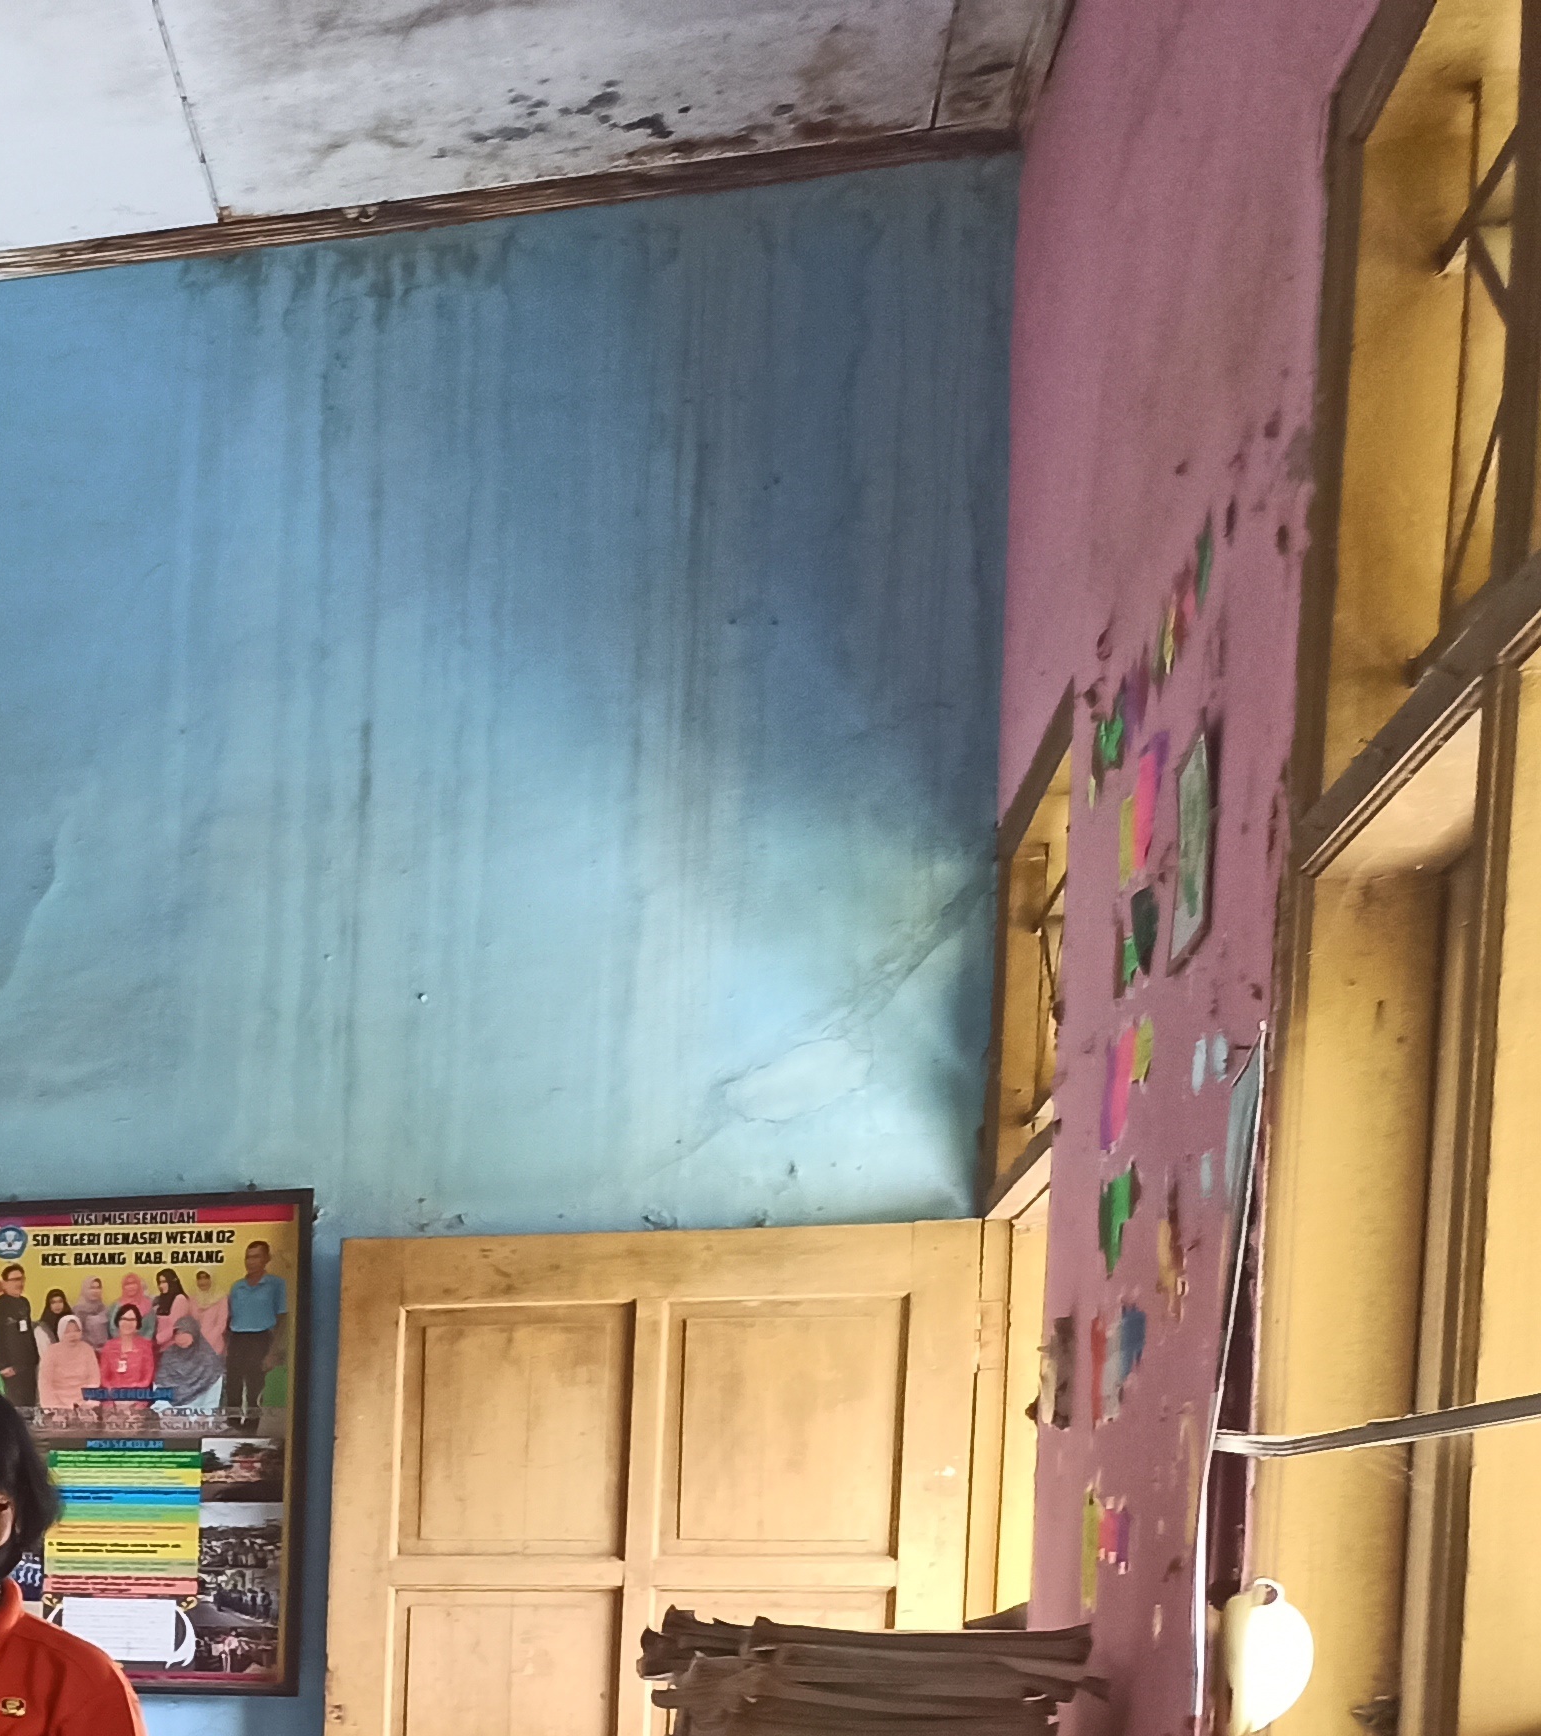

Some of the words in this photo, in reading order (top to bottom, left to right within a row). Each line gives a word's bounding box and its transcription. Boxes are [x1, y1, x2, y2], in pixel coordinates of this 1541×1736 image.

[72, 1212, 102, 1226] VISI
[103, 1211, 129, 1225] MISI
[133, 1210, 196, 1225] SEKOLAH
[32, 1233, 52, 1247] SD
[53, 1232, 101, 1247] NEGERI
[103, 1231, 163, 1246] DENASRI
[166, 1230, 214, 1244] WETAN
[216, 1229, 235, 1244] 02
[73, 1251, 126, 1266] BATANG
[171, 1249, 224, 1264] BATANG
